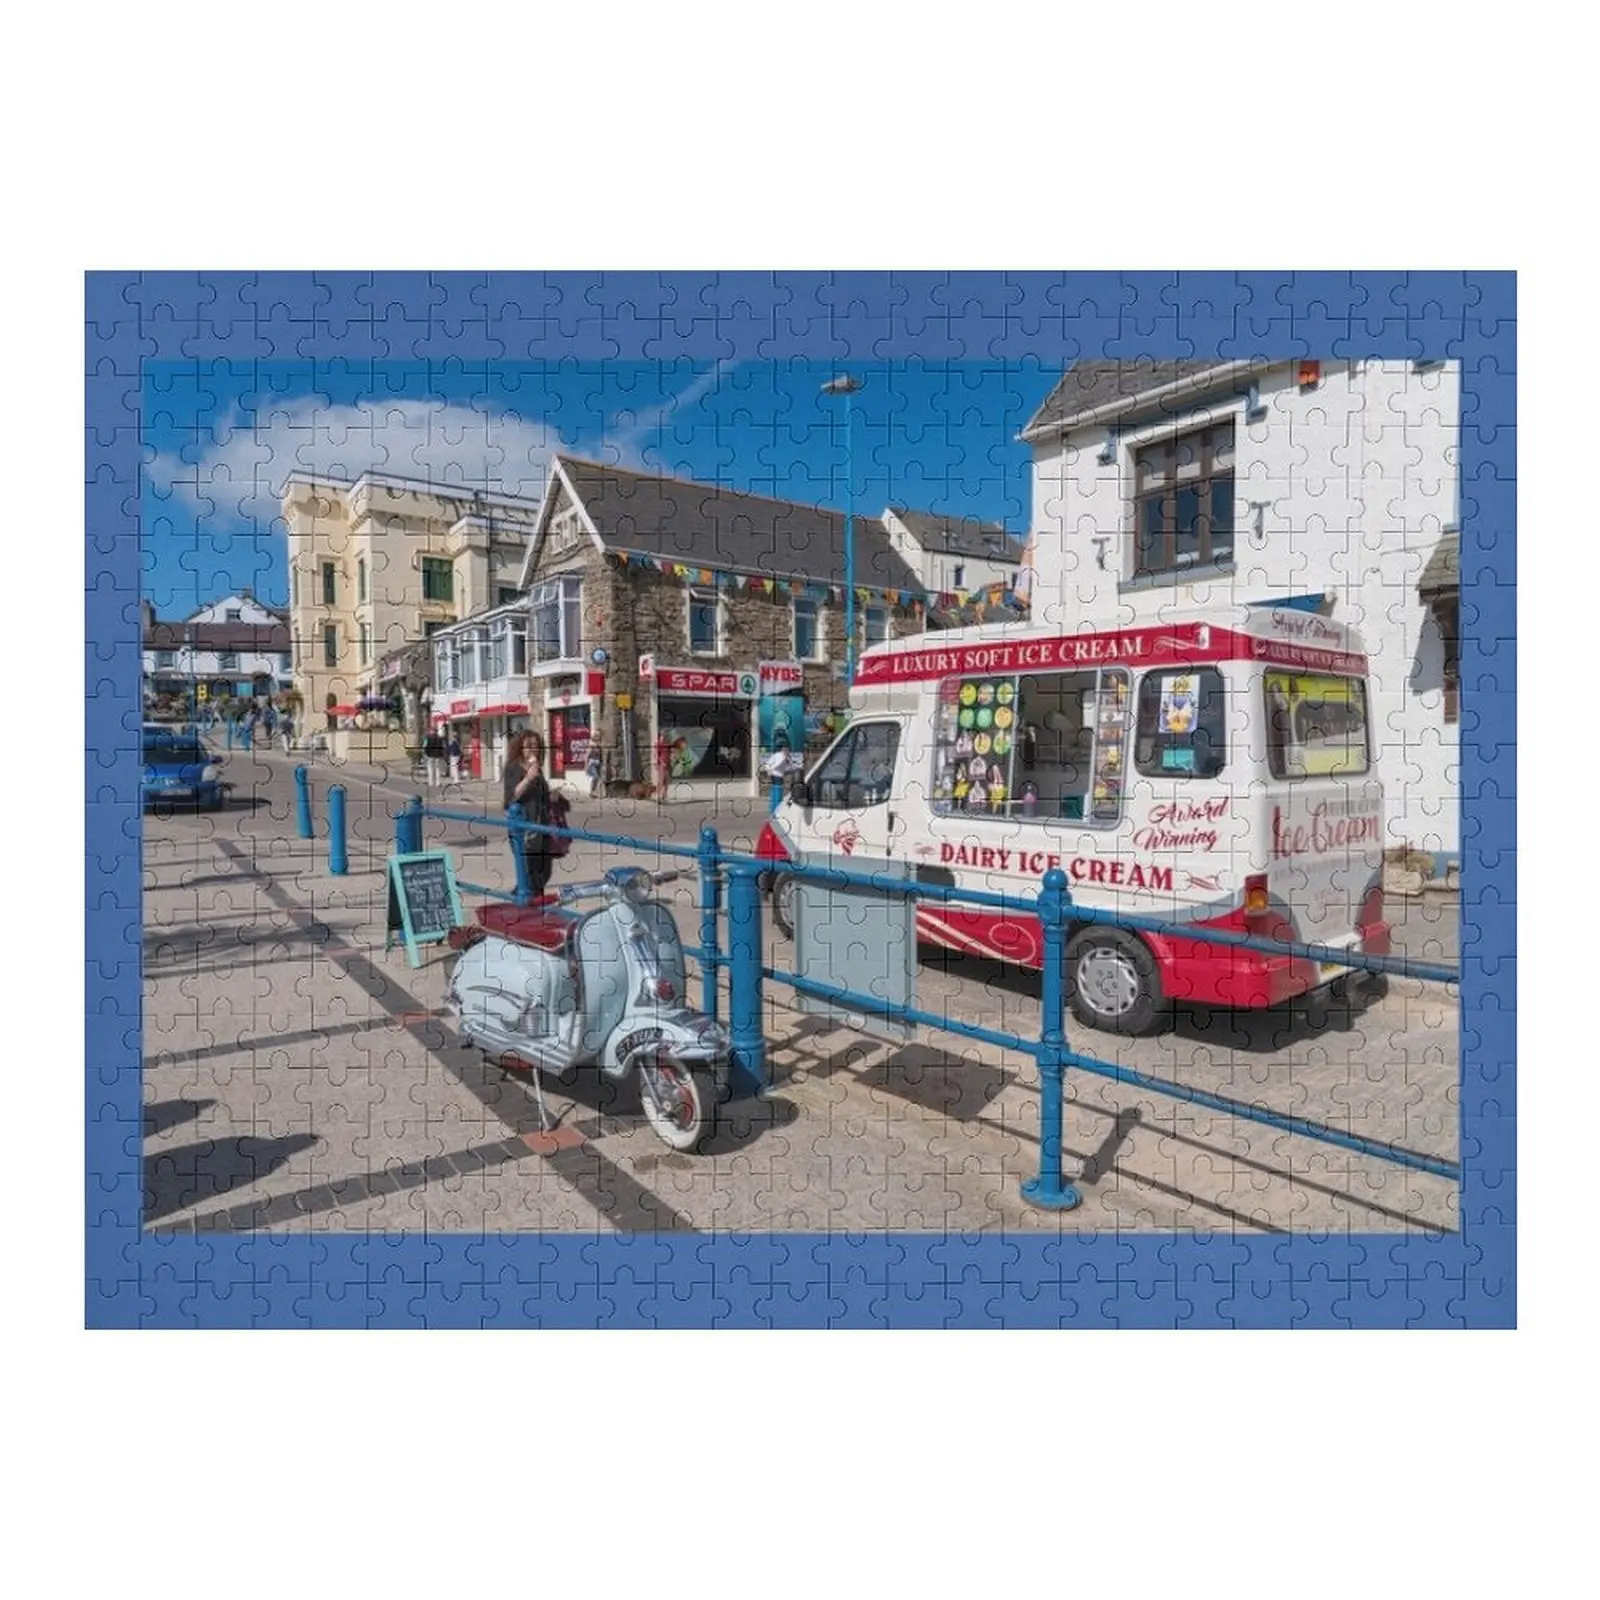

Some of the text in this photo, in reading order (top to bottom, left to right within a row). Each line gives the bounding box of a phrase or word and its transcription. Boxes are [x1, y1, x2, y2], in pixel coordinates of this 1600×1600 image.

[893, 635, 1144, 674] LUXURY SOFT ICE CREAM
[671, 673, 736, 690] SPAR
[1148, 796, 1229, 827] Award
[1133, 826, 1219, 852] Winning
[940, 842, 1173, 891] DAIRY ICE CREAM
